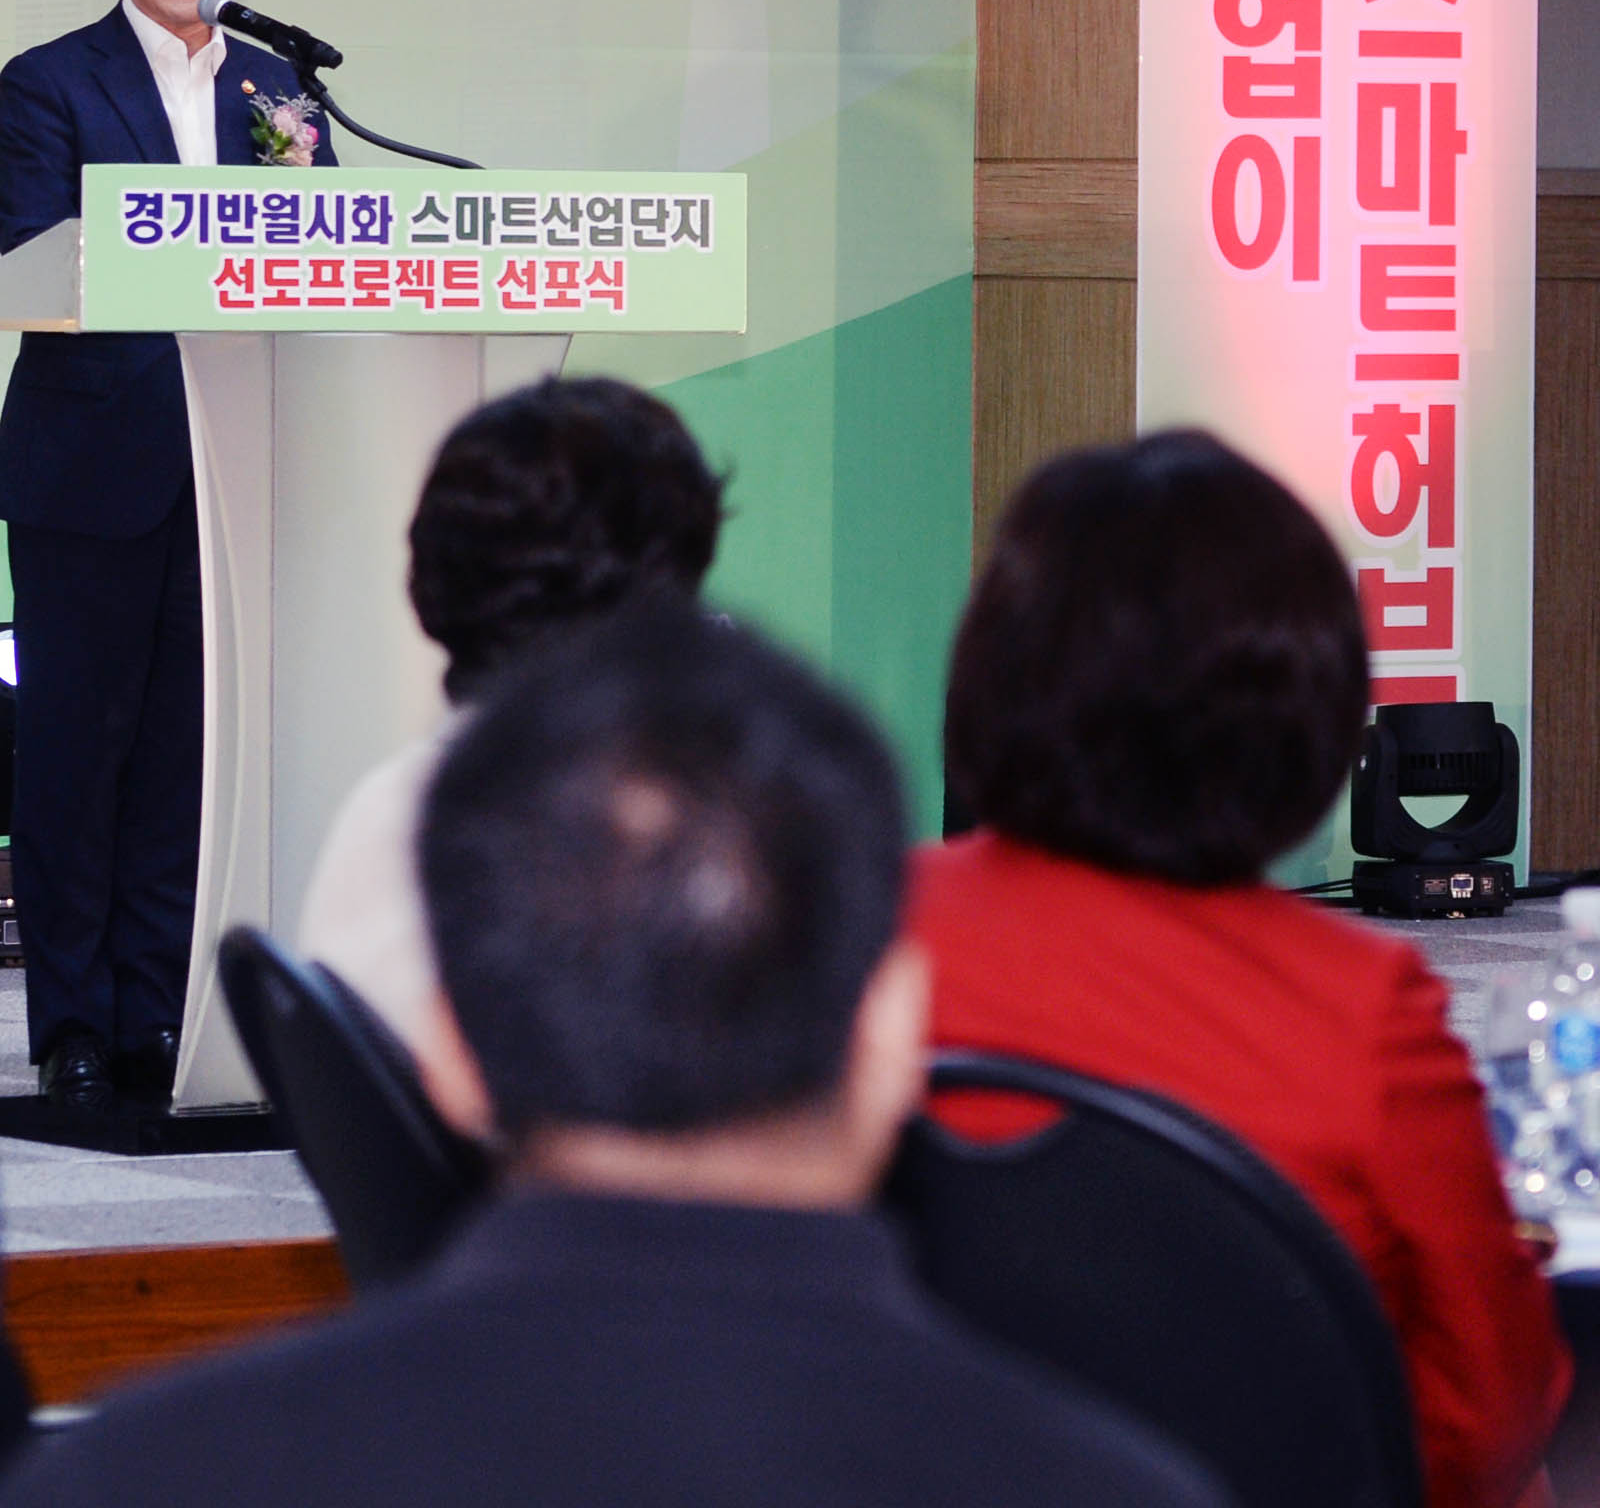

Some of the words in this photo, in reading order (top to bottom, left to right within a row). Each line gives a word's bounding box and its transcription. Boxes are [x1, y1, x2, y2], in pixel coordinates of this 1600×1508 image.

[123, 192, 393, 245] 경기반월시화
[411, 196, 710, 248] 스마트산업단지
[213, 257, 481, 310] 선도프로젝트
[496, 259, 625, 310] 선포식
